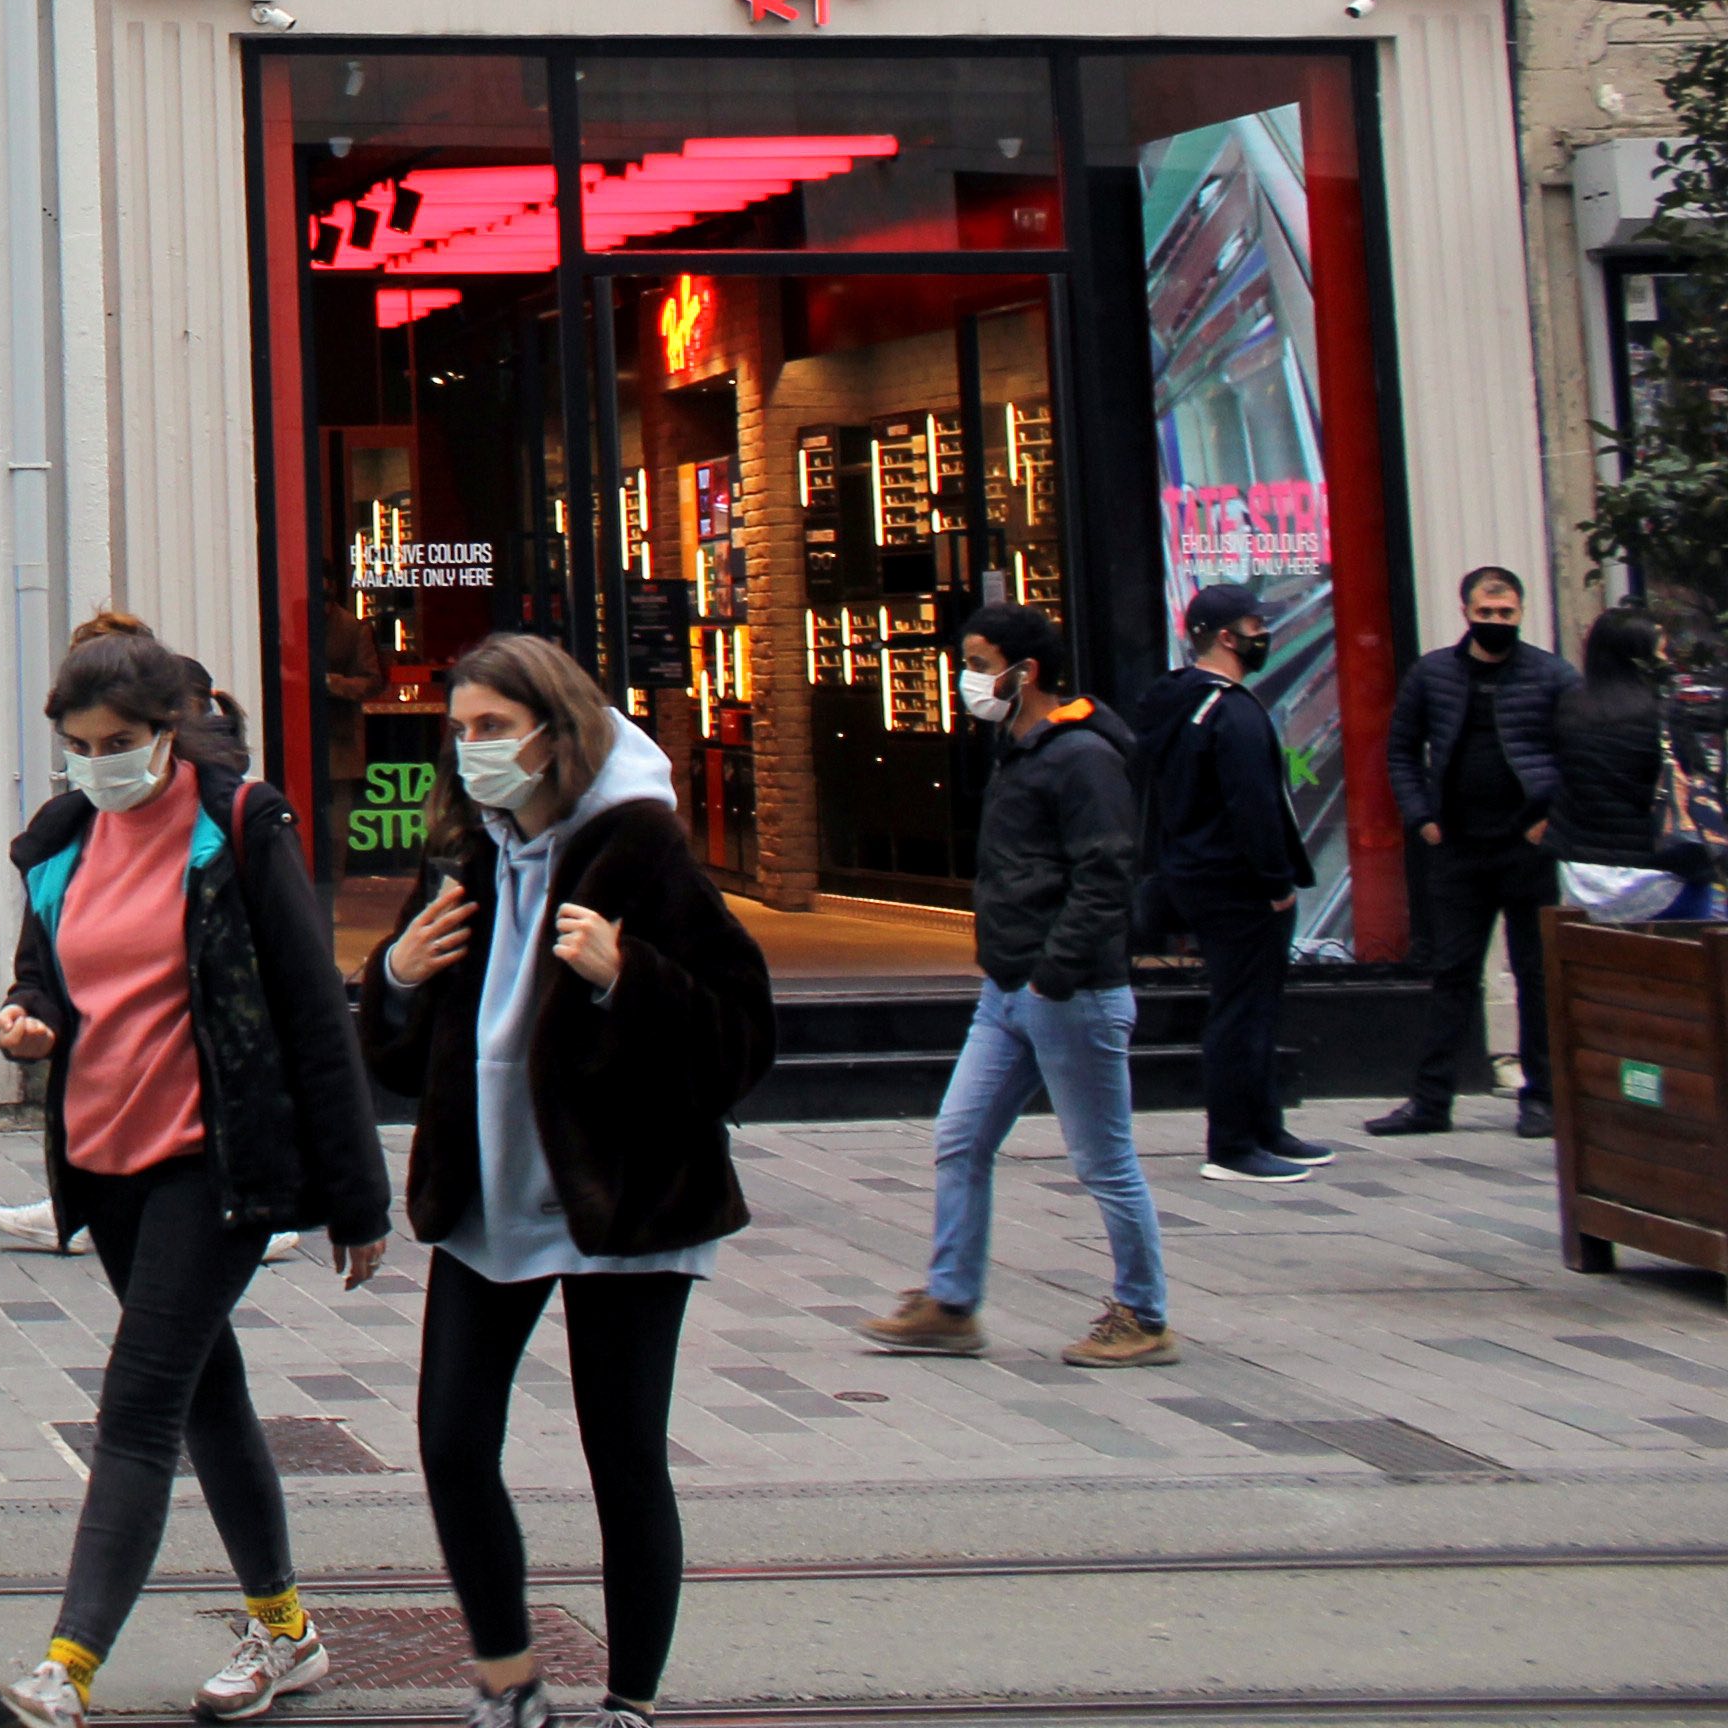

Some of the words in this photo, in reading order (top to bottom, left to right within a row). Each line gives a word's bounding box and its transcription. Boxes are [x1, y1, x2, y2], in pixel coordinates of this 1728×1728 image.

[428, 542, 494, 564] COLOURS
[1258, 532, 1320, 554] COLOURS
[423, 568, 456, 588] ONLY
[459, 567, 494, 587] HERE
